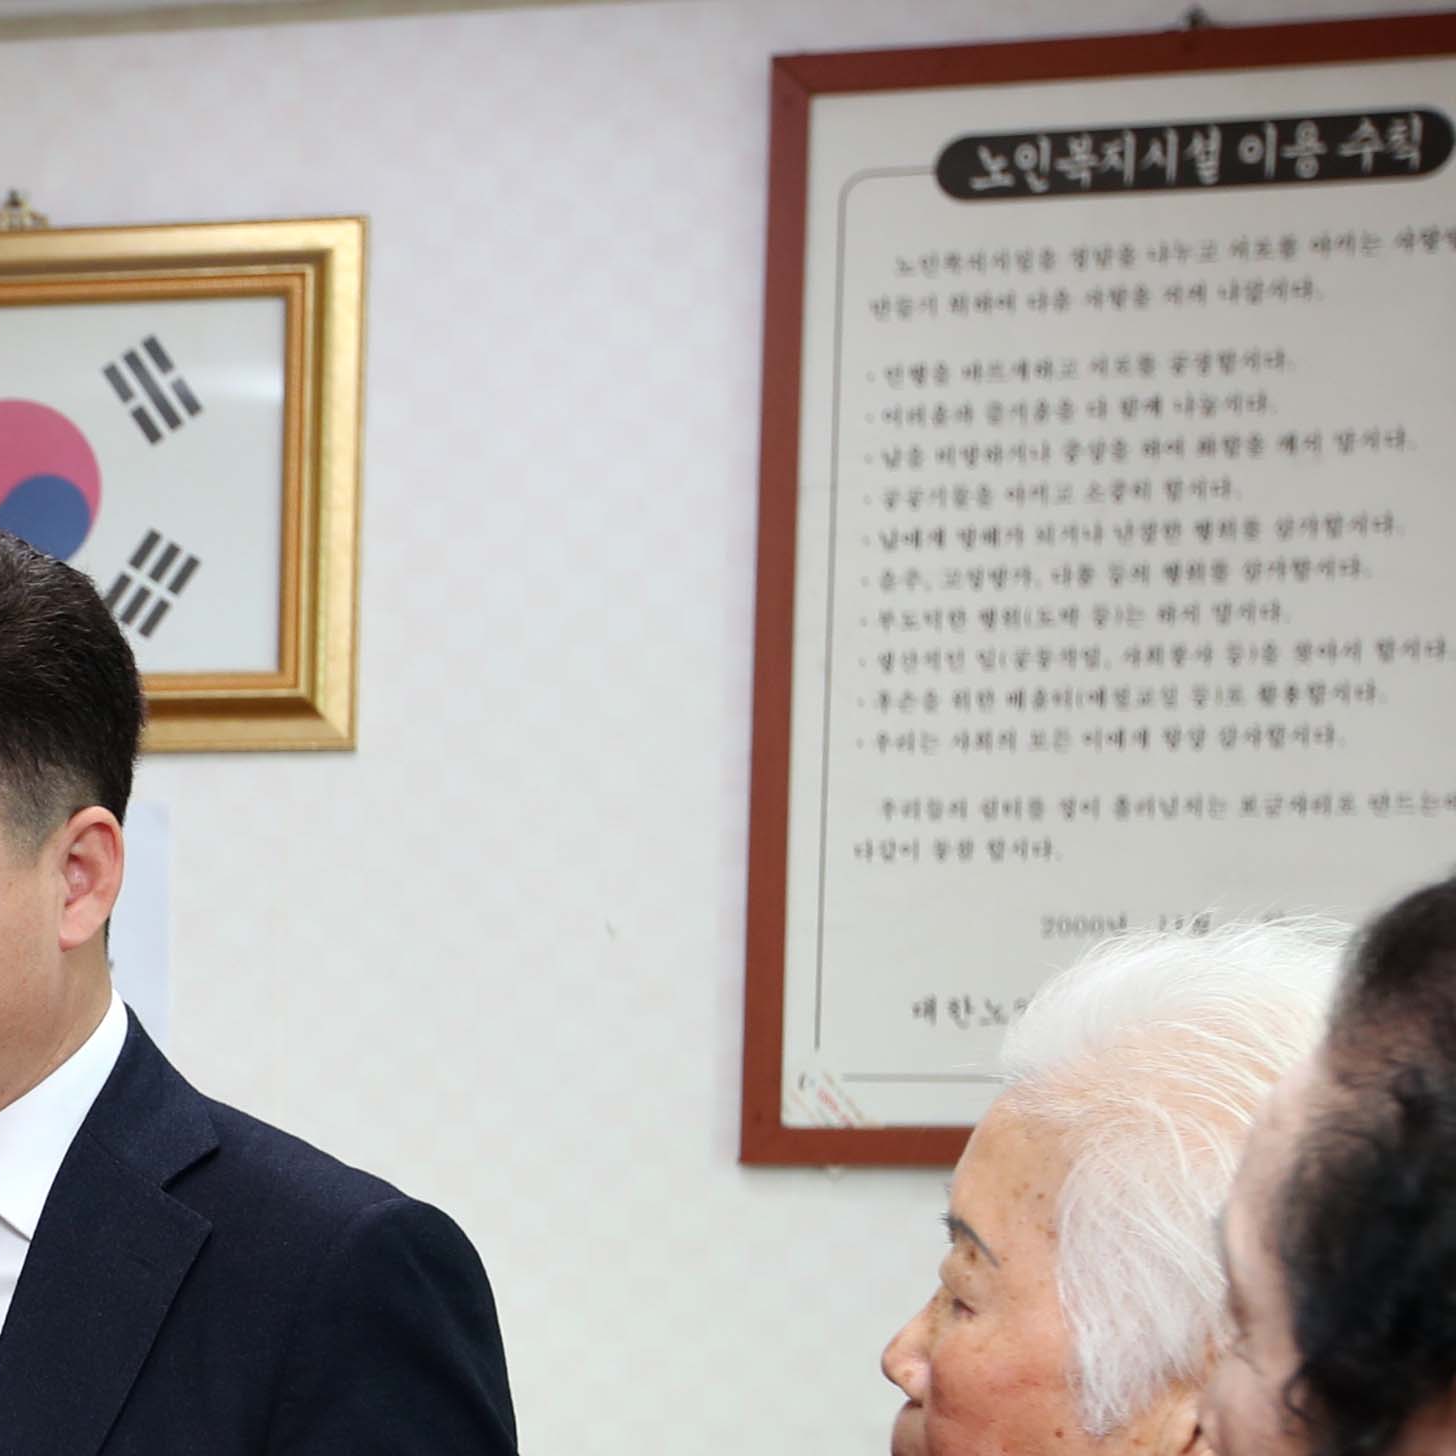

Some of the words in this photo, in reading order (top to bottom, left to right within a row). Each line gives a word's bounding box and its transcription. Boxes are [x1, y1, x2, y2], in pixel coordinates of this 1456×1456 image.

[970, 122, 1221, 194] 노인복지시설
[1237, 119, 1327, 180] 이용
[1338, 111, 1421, 174] 수칙
